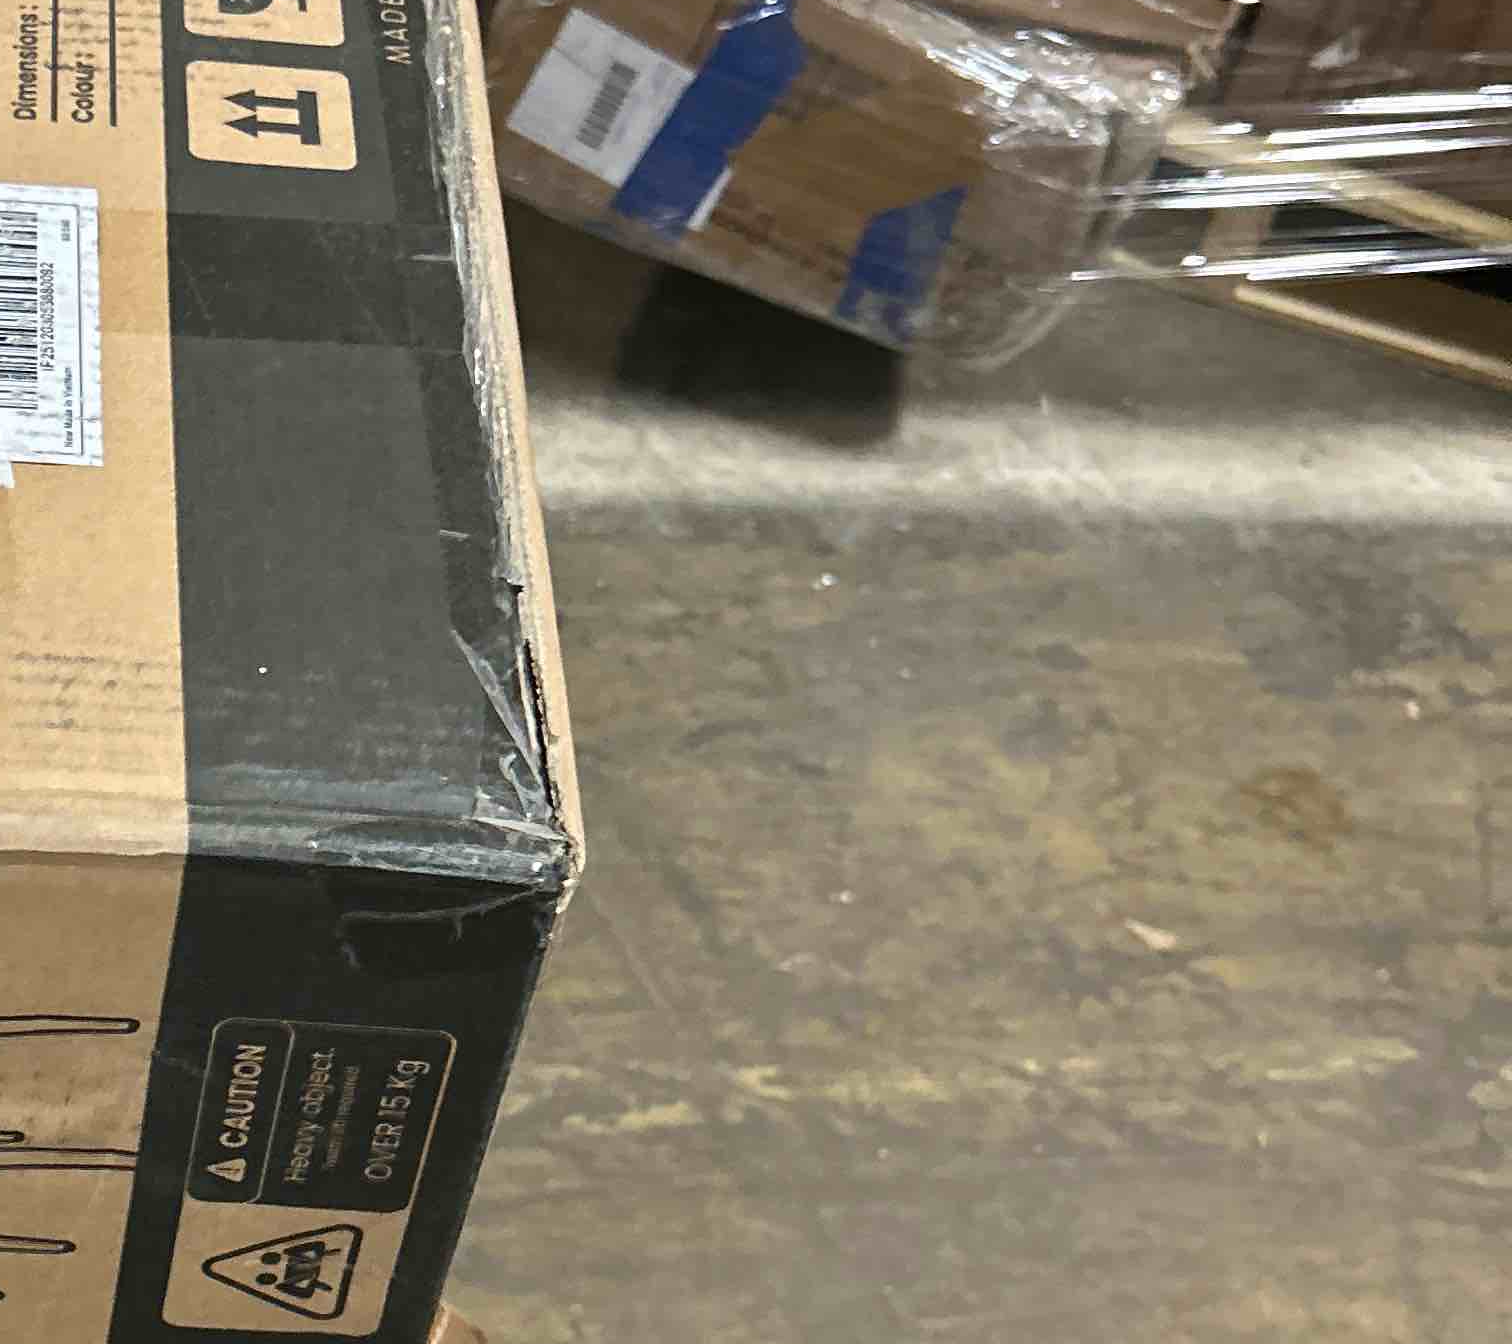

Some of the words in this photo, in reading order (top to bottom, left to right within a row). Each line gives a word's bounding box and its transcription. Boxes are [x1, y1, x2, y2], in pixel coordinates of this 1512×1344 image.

[13, 4, 38, 120] Dimensions:
[72, 52, 95, 123] Colour:
[218, 1044, 267, 1148] CAUTION
[298, 1047, 336, 1114] object.
[379, 1095, 410, 1117] 15
[384, 1060, 431, 1089] Kg
[282, 1120, 323, 1184] Heavy
[364, 1124, 404, 1181] OVER
